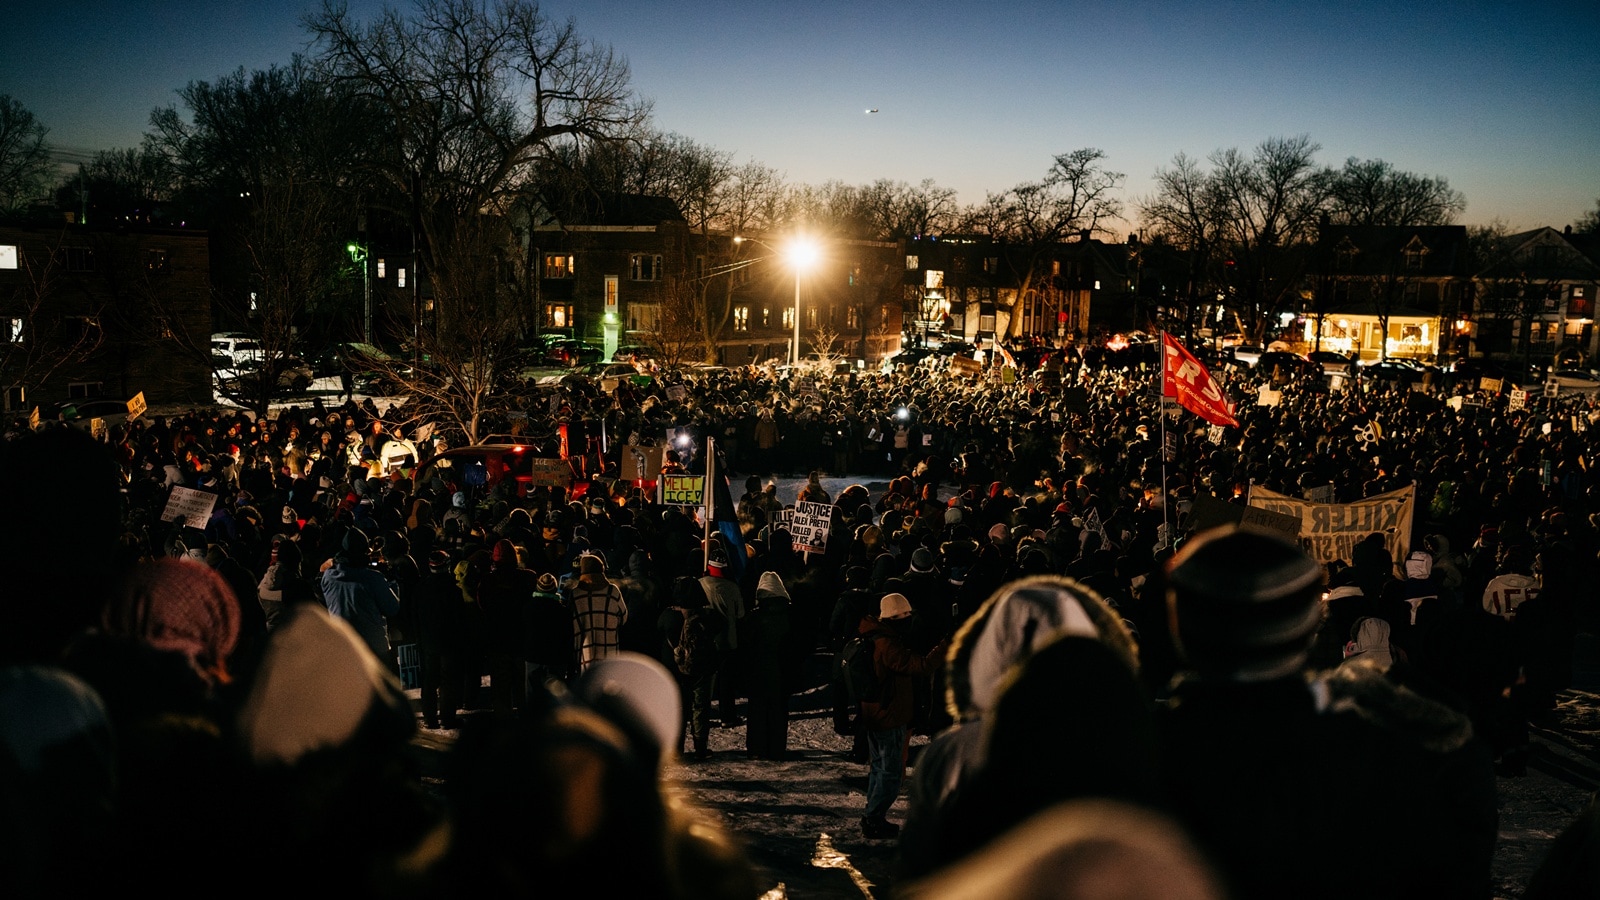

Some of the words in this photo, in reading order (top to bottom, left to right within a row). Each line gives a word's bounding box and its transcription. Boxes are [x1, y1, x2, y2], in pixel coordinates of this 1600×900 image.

[664, 477, 698, 491] MELT
[665, 490, 702, 505] ICE!
[796, 501, 831, 518] JUSTICE
[772, 510, 795, 523] KILLE
[793, 516, 809, 526] ALEX
[808, 518, 829, 529] PRETTI
[792, 525, 812, 536] KILLED
[791, 534, 799, 543] BY
[799, 535, 809, 545] ICE
